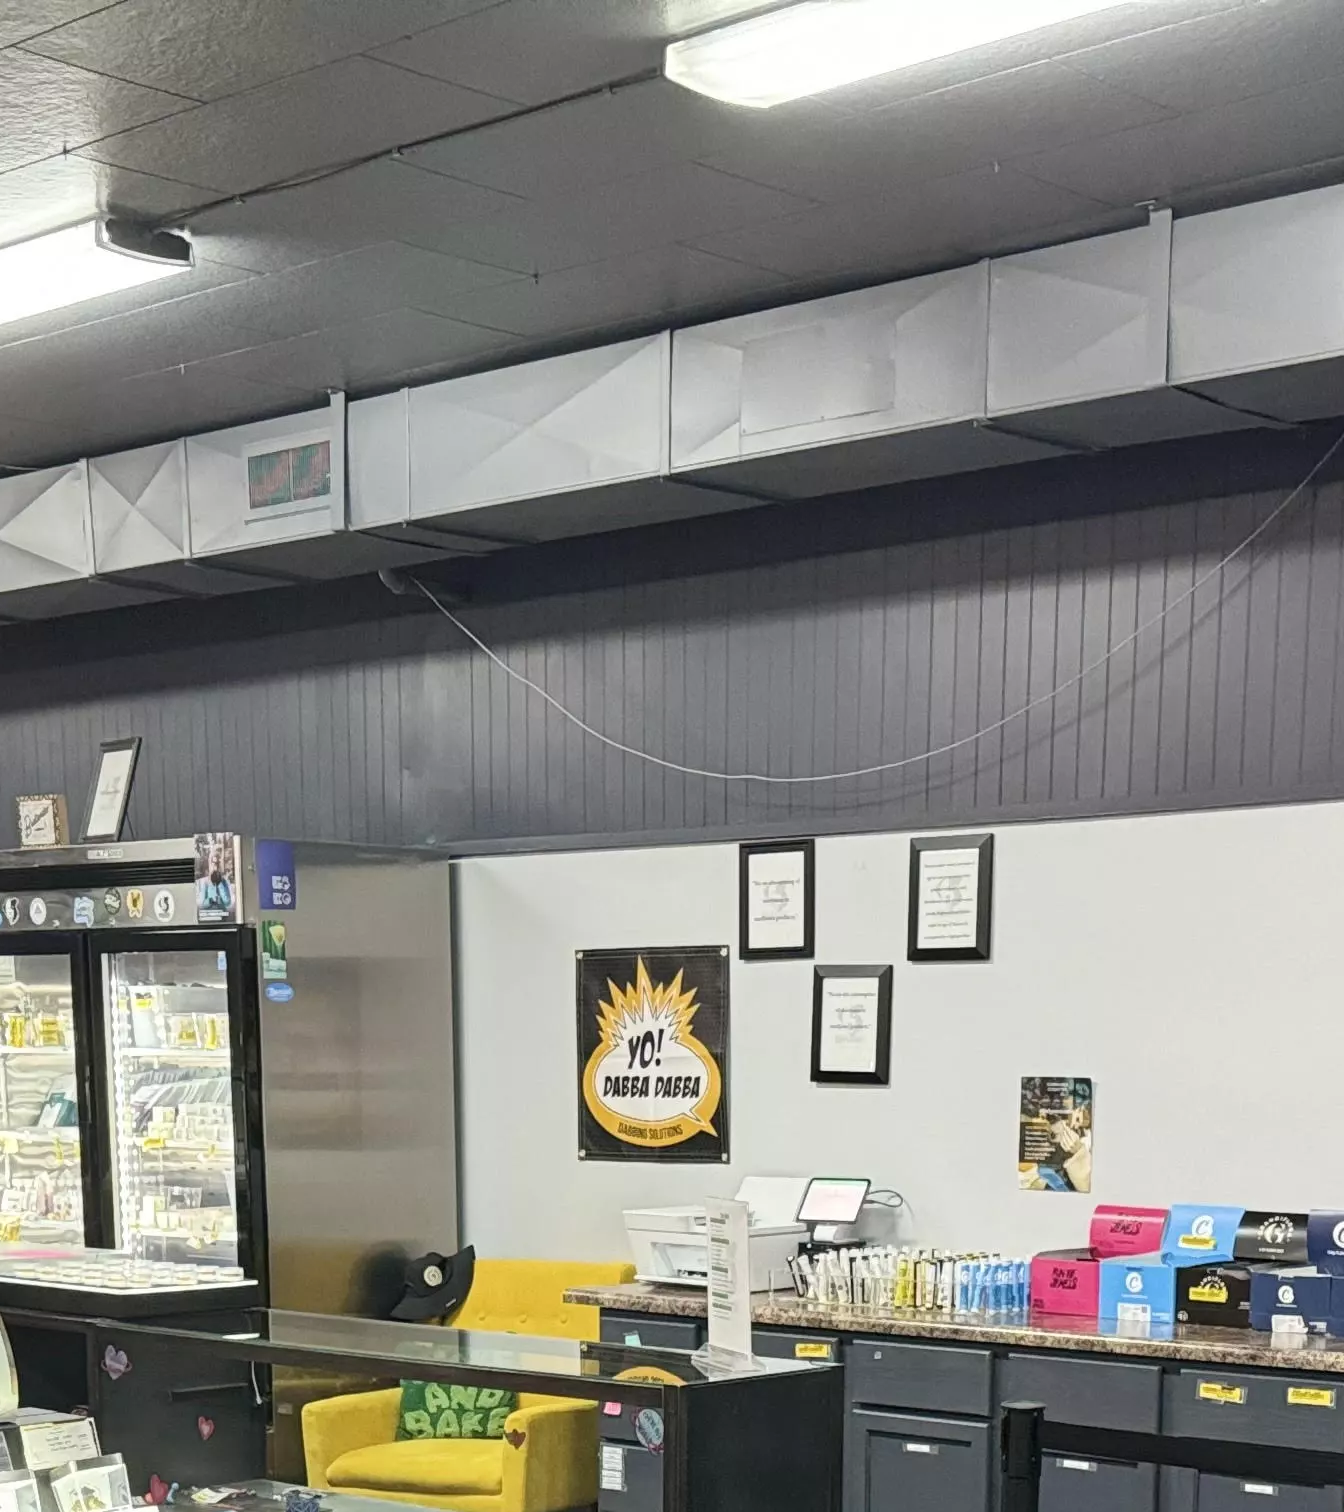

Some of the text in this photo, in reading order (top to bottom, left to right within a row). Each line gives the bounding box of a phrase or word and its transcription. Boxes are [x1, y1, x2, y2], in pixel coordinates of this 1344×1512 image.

[627, 1028, 665, 1070] YO!
[603, 1075, 702, 1098] DABBA DABBA
[424, 1382, 504, 1413] AND
[404, 1406, 511, 1438] BAKE
